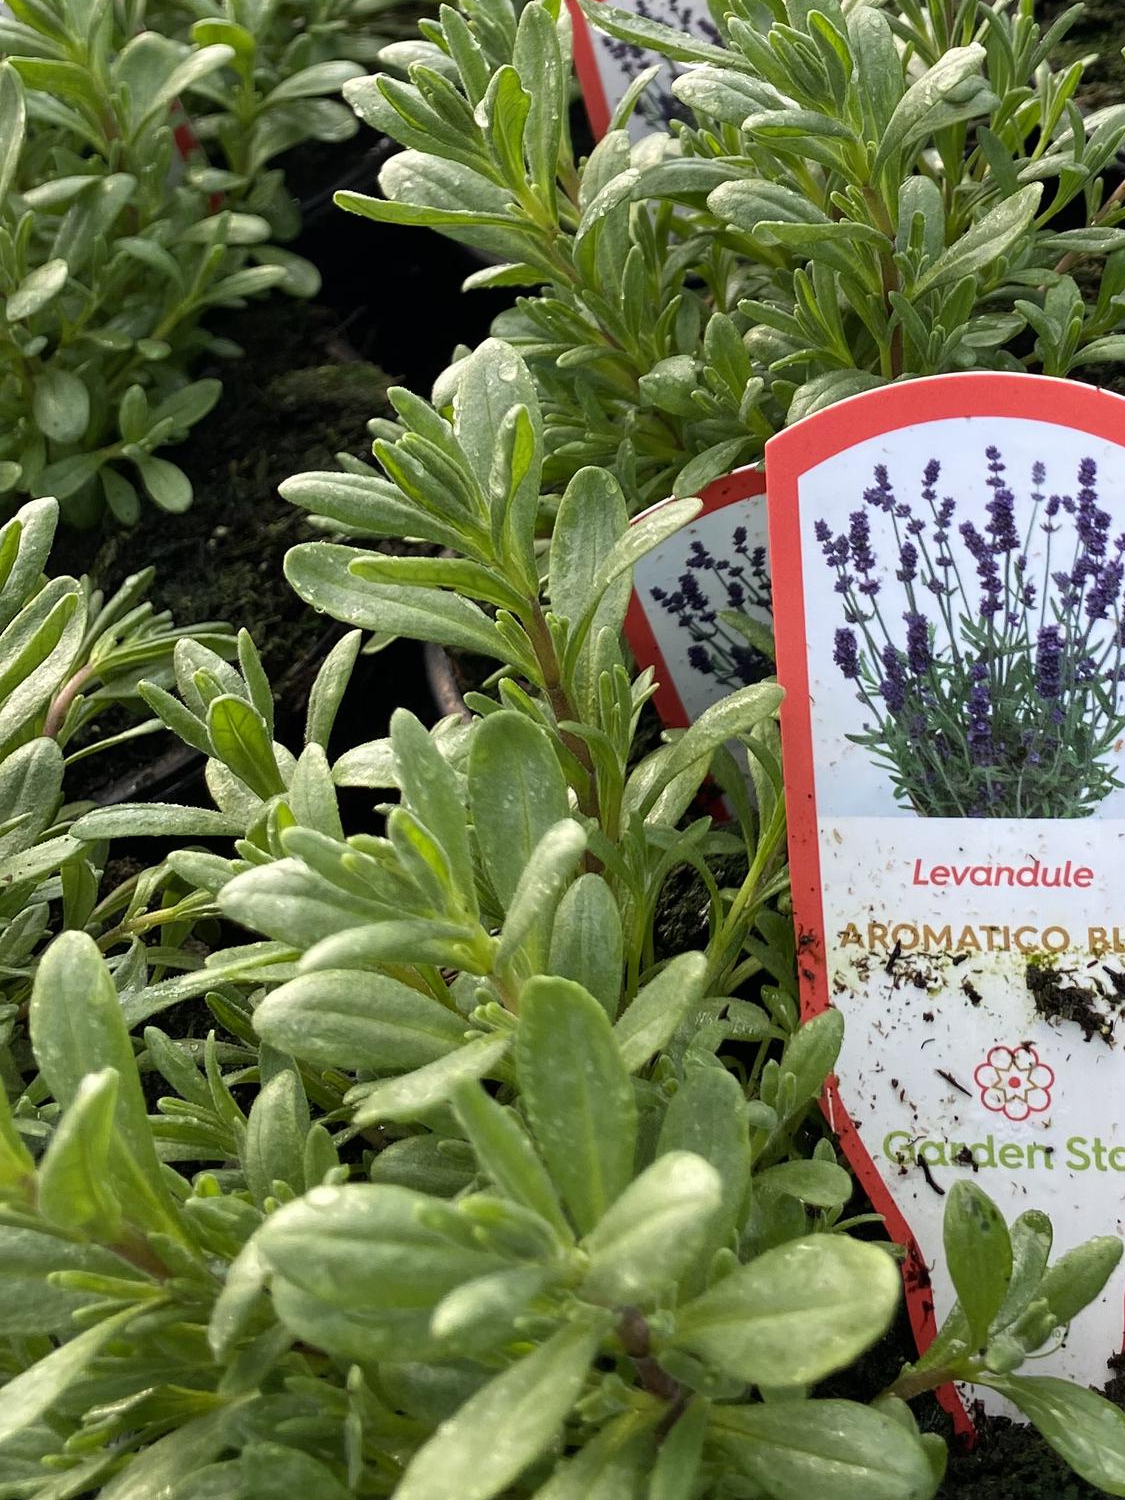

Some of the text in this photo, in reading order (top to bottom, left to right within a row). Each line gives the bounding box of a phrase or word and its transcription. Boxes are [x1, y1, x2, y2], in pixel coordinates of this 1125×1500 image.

[912, 858, 1095, 889] Levandule
[838, 922, 1071, 954] AROMATICO
[882, 1129, 1055, 1171] Garden
